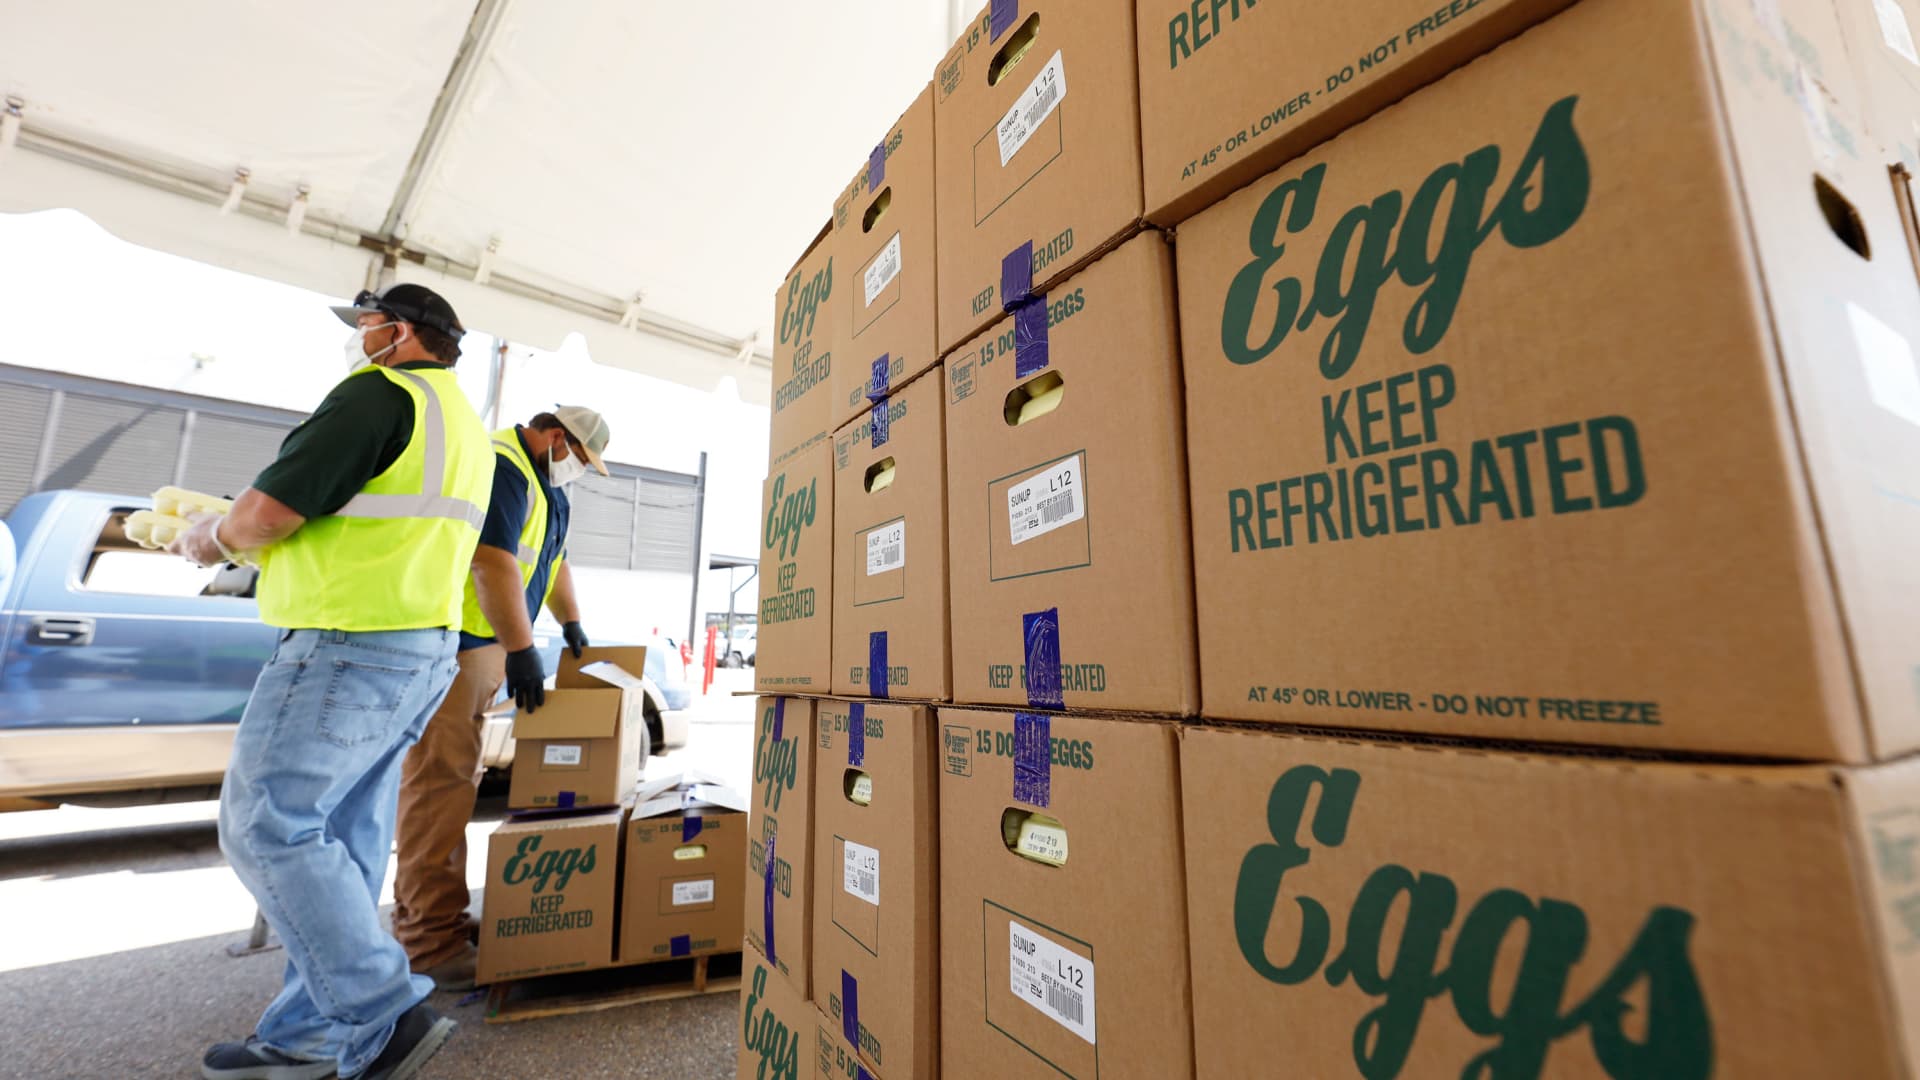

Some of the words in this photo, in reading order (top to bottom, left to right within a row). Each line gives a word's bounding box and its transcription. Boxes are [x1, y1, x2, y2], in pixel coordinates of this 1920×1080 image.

[967, 27, 980, 54] 15
[1000, 109, 1019, 137] SUNUP
[1181, 160, 1197, 181] AT
[1225, 130, 1248, 153] OR
[1251, 91, 1312, 138] LOWER
[1326, 65, 1355, 93] DO
[1359, 36, 1401, 73] NOT
[1220, 94, 1592, 380] Eggs
[780, 255, 833, 348] Eggs
[972, 285, 995, 318] KEEP
[980, 340, 995, 367] 15
[1047, 287, 1086, 329] EGGS
[793, 339, 812, 376] KEEP
[775, 351, 831, 414] REFRIGERATED
[1321, 362, 1457, 465] KEEP
[852, 427, 860, 446] 15
[1011, 488, 1031, 508] SUNUP
[1050, 470, 1072, 493] L12
[1228, 414, 1648, 554] REFRIGERATED
[766, 473, 817, 562] Eggs
[778, 562, 797, 593] KEEP
[761, 586, 816, 625] REFRIGERATED
[850, 666, 863, 685] KEEP
[988, 664, 1013, 689] KEEP
[1247, 686, 1268, 702] AT
[1303, 688, 1332, 706] OR
[1336, 690, 1412, 711] LOWER
[1433, 694, 1468, 715] DO
[1476, 696, 1530, 717] NOT
[1539, 698, 1663, 726] FREEZE
[834, 714, 841, 732] 15
[865, 718, 884, 739] EGGS
[756, 707, 798, 813] Eggs
[976, 730, 992, 754] 15
[1049, 737, 1095, 770] EGGS
[503, 834, 597, 894] Eggs
[496, 909, 593, 938] REFRIGERATED
[530, 894, 565, 915] KEEP
[1233, 764, 1717, 1080] Eggs
[1013, 934, 1036, 957] SUNUP
[1058, 959, 1084, 989] L12
[1041, 972, 1053, 985] BEST
[744, 965, 799, 1080] Eggs
[837, 1046, 845, 1071] 15
